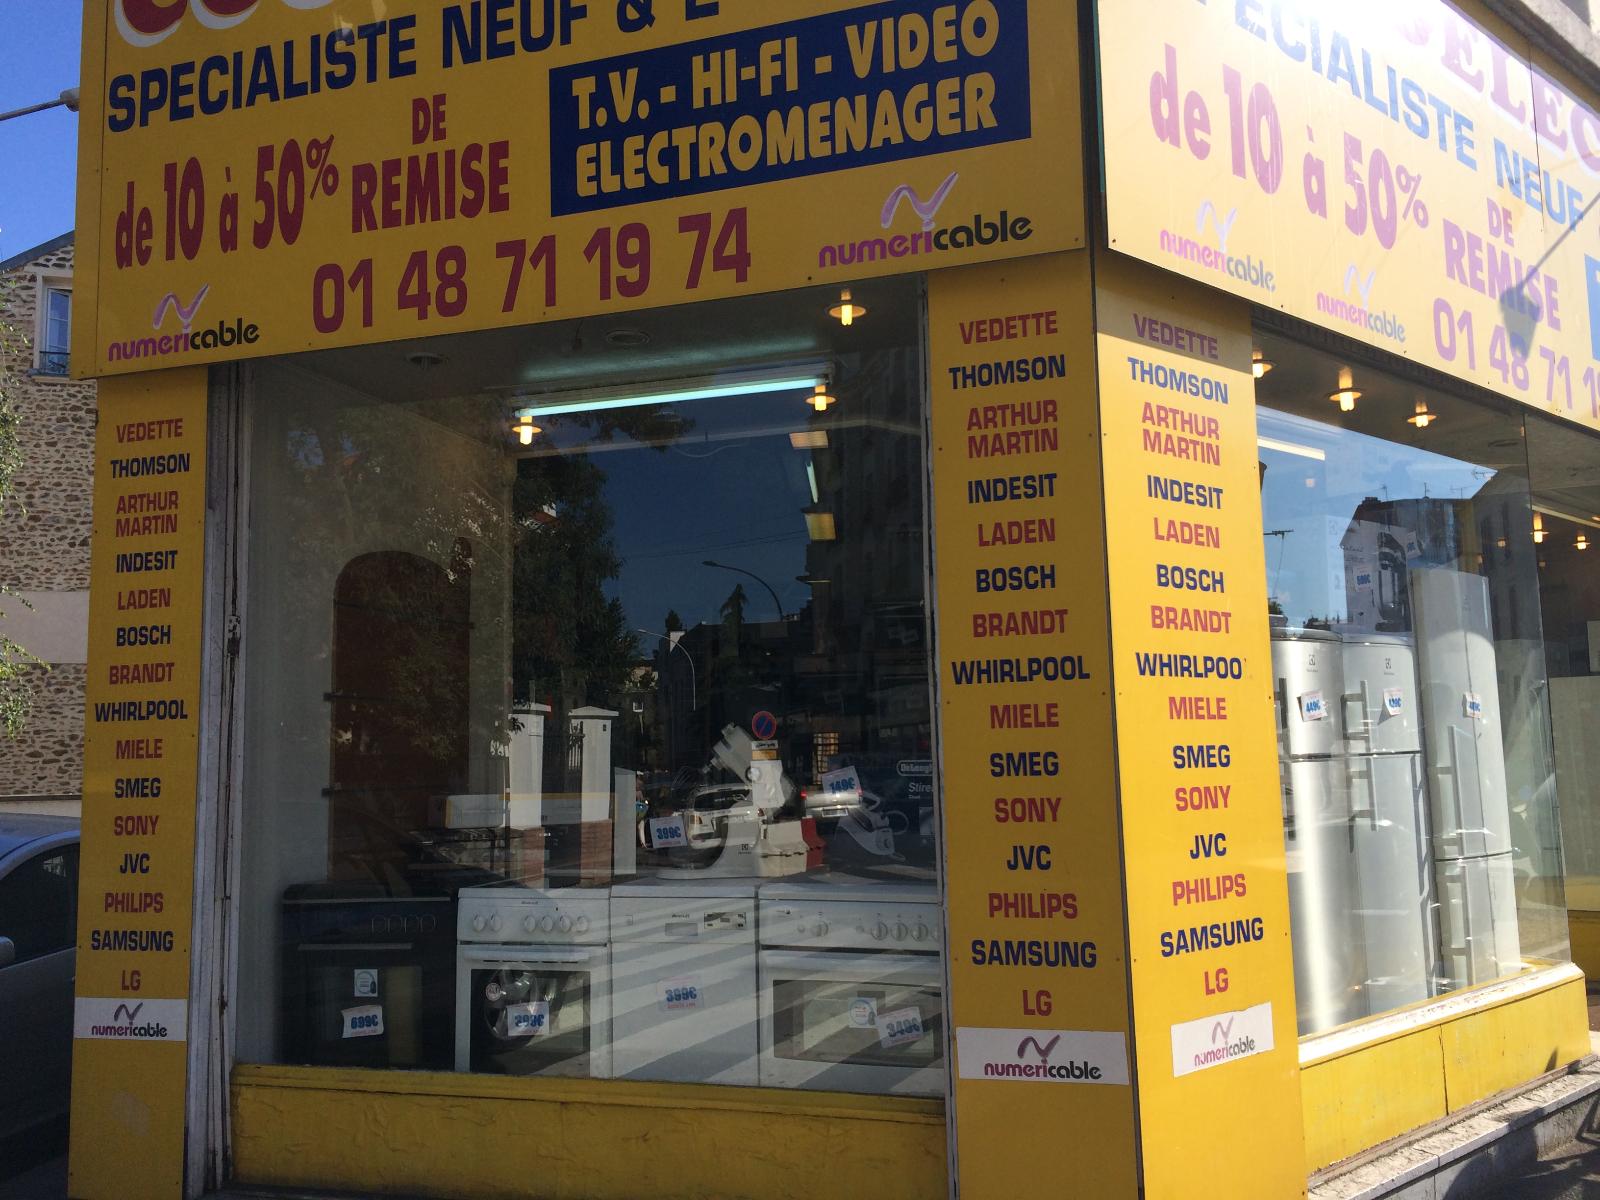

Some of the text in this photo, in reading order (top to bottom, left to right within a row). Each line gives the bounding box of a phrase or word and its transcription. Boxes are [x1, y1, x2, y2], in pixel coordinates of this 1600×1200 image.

[107, 14, 417, 133] SPECIALISTE
[442, 0, 588, 68] NEUF
[571, 67, 650, 131] T.V.
[692, 36, 799, 109] HI-FI
[845, 0, 999, 79] VIDEO
[411, 93, 448, 145] DE
[575, 71, 998, 198] ELECTROMENAGER
[1149, 42, 1430, 251] de 10 à 50%
[352, 140, 510, 234] REMISE
[1493, 137, 1584, 232] NEUF
[115, 133, 340, 270] de 10 à 50%
[1487, 197, 1515, 248] DE
[817, 211, 1034, 270] numericable
[312, 207, 752, 335] 01 48 71 19 74
[1158, 229, 1277, 294] numericable
[1442, 217, 1562, 333] REMISE
[959, 310, 1059, 345] VEDETTE
[1316, 291, 1407, 344] numericable
[107, 318, 261, 363] numericable
[1133, 312, 1220, 361] VEDETTE
[1432, 297, 1477, 372] 01
[1488, 325, 1531, 392] 48
[1539, 345, 1574, 410] 71
[949, 354, 1066, 391] THOMSON
[1127, 356, 1229, 405] THOMSON
[116, 417, 184, 444] VEDETTE
[966, 400, 1059, 432] ARTHUR
[1141, 401, 1221, 442] ARTHUR
[967, 428, 1059, 459] MARTIN
[1142, 428, 1221, 467] MARTIN
[110, 452, 191, 479] THOMSON
[115, 490, 179, 515] ARTHUR
[968, 472, 1058, 505] INDESIT
[1146, 474, 1224, 510] INDESIT
[115, 513, 178, 538] MARTIN
[977, 518, 1056, 548] LADEN
[1153, 517, 1221, 549] LADEN
[115, 550, 178, 574] INDESIT
[975, 564, 1057, 594] BOSCH
[1155, 563, 1225, 594] BOSCH
[117, 587, 171, 611] LADEN
[972, 608, 1069, 639] BRANDT
[1150, 605, 1232, 635] BRANDT
[116, 624, 171, 648] BOSCH
[108, 662, 175, 686] BRANDT
[951, 655, 1091, 686] WHIRLPOOL
[1135, 652, 1247, 681] WHIRLPOO
[94, 699, 189, 723] WHIRLPOOL
[989, 702, 1060, 730] MIELE
[1168, 696, 1228, 721] MIELE
[115, 738, 163, 760] MIELE
[1172, 744, 1231, 769] SMEG
[989, 751, 1060, 779] SMEG
[114, 777, 161, 799] SMEG
[1175, 784, 1232, 812] SONY
[994, 797, 1063, 824] SONY
[113, 815, 160, 837] SONY
[1006, 844, 1053, 871] JVC
[1189, 832, 1228, 860] JVC
[119, 853, 150, 875] JVC
[104, 892, 164, 914] PHILIPS
[1172, 873, 1248, 907] PHILIPS
[988, 892, 1079, 920] PHILIPS
[91, 930, 174, 953] SAMSUNG
[1160, 916, 1265, 959] SAMSUNG
[970, 939, 1098, 969] SAMSUNG
[121, 970, 142, 992] LG
[1203, 967, 1230, 997] LG
[1022, 989, 1053, 1018] LG
[91, 1022, 168, 1039] numericable
[1193, 1035, 1257, 1068] numericable
[984, 1059, 1103, 1081] numericable
